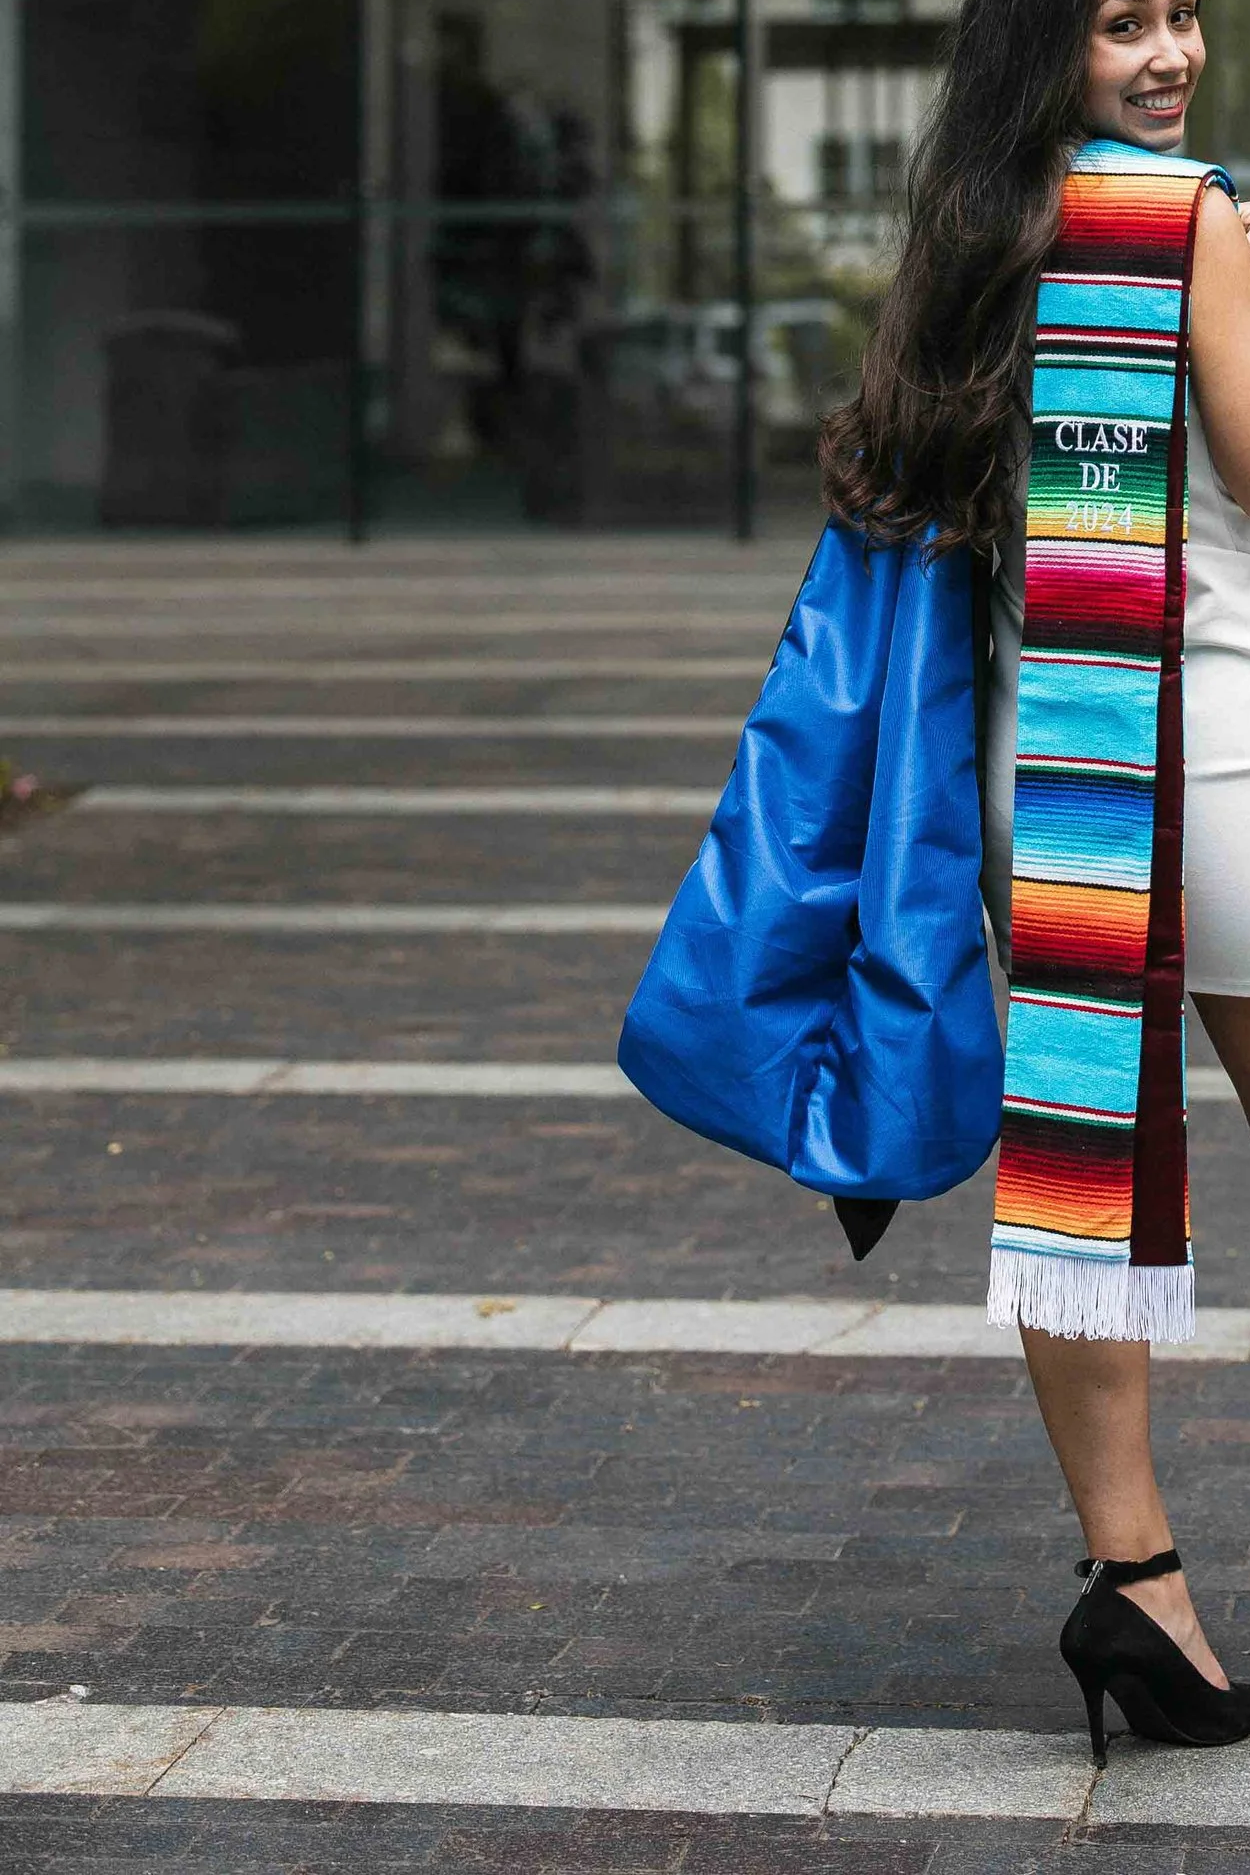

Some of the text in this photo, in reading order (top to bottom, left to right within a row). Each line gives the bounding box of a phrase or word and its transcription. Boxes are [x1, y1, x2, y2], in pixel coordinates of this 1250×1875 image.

[1055, 422, 1148, 453] CLASE
[1079, 462, 1120, 492] DE
[1065, 501, 1133, 536] 2024
